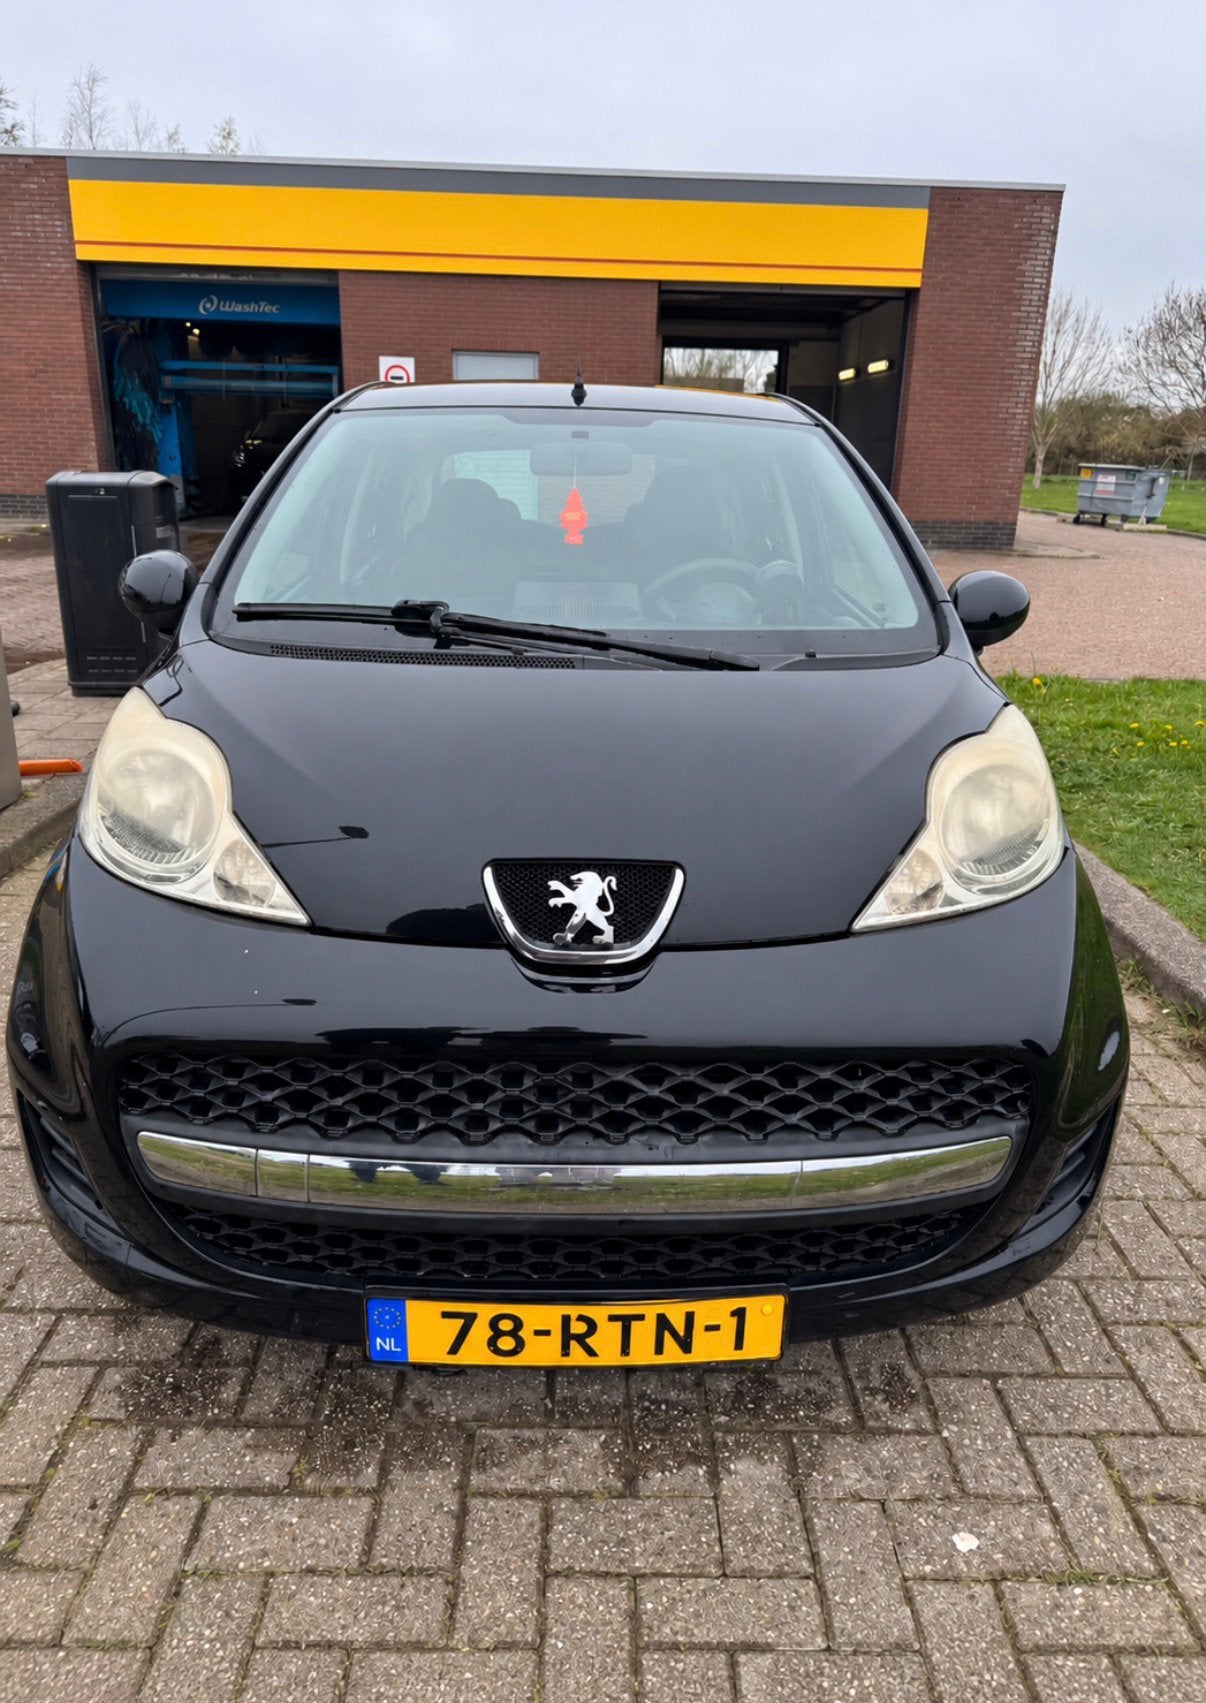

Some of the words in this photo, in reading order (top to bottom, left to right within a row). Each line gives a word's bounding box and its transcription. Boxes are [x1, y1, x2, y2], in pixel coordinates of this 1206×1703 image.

[219, 300, 280, 314] WashTec
[440, 1306, 747, 1358] 78-RTN-1
[376, 1337, 402, 1352] NL
